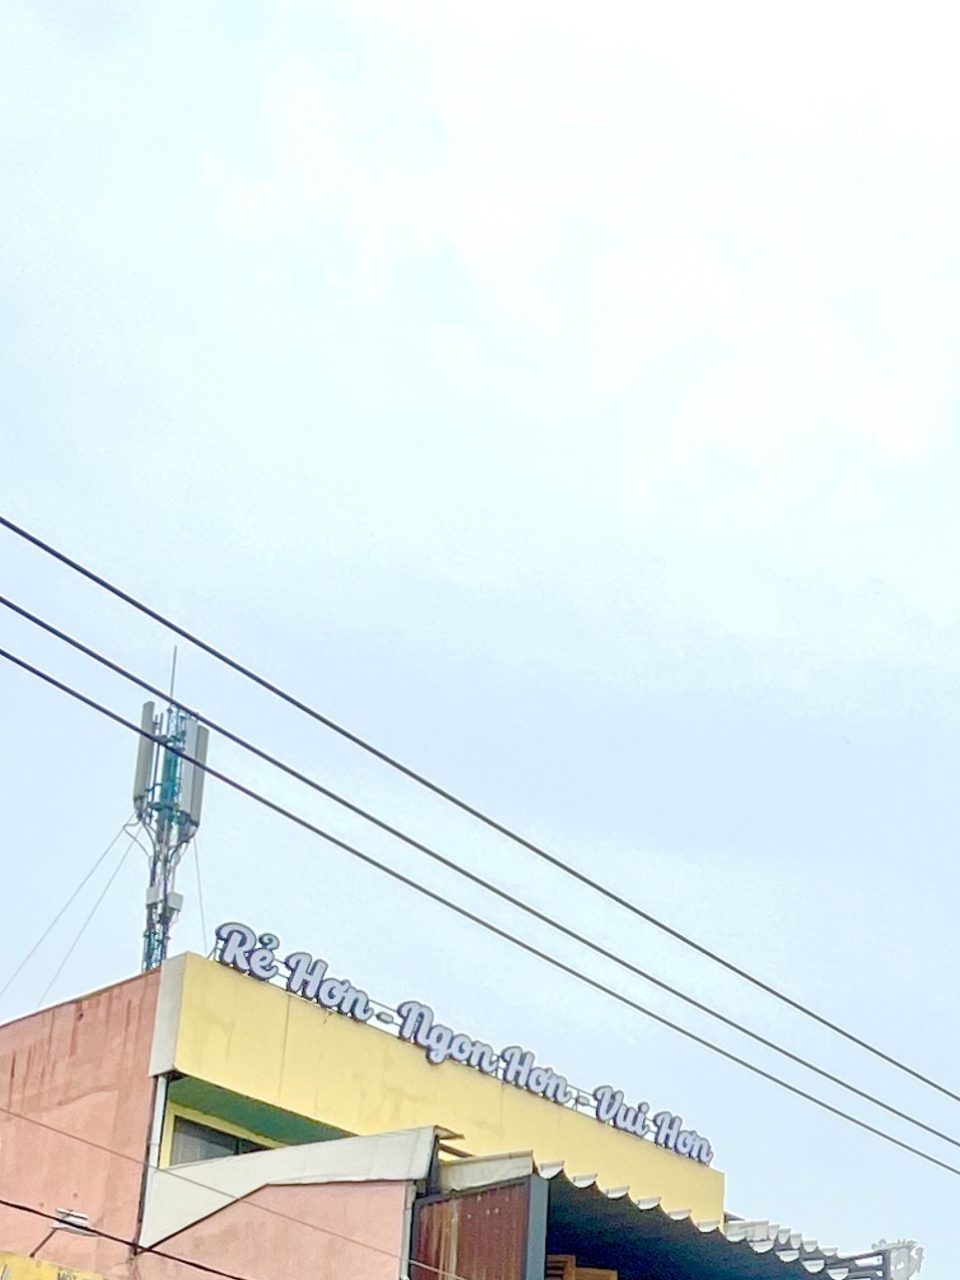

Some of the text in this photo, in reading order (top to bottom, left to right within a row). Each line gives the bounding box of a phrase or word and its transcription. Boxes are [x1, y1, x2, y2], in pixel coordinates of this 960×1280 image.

[215, 921, 279, 980] Rẻ
[284, 951, 373, 1022] Hơn
[397, 1000, 498, 1065] Ngon
[501, 1045, 571, 1105] Hơn
[593, 1085, 650, 1135] Vui
[653, 1110, 713, 1162] Hơn
